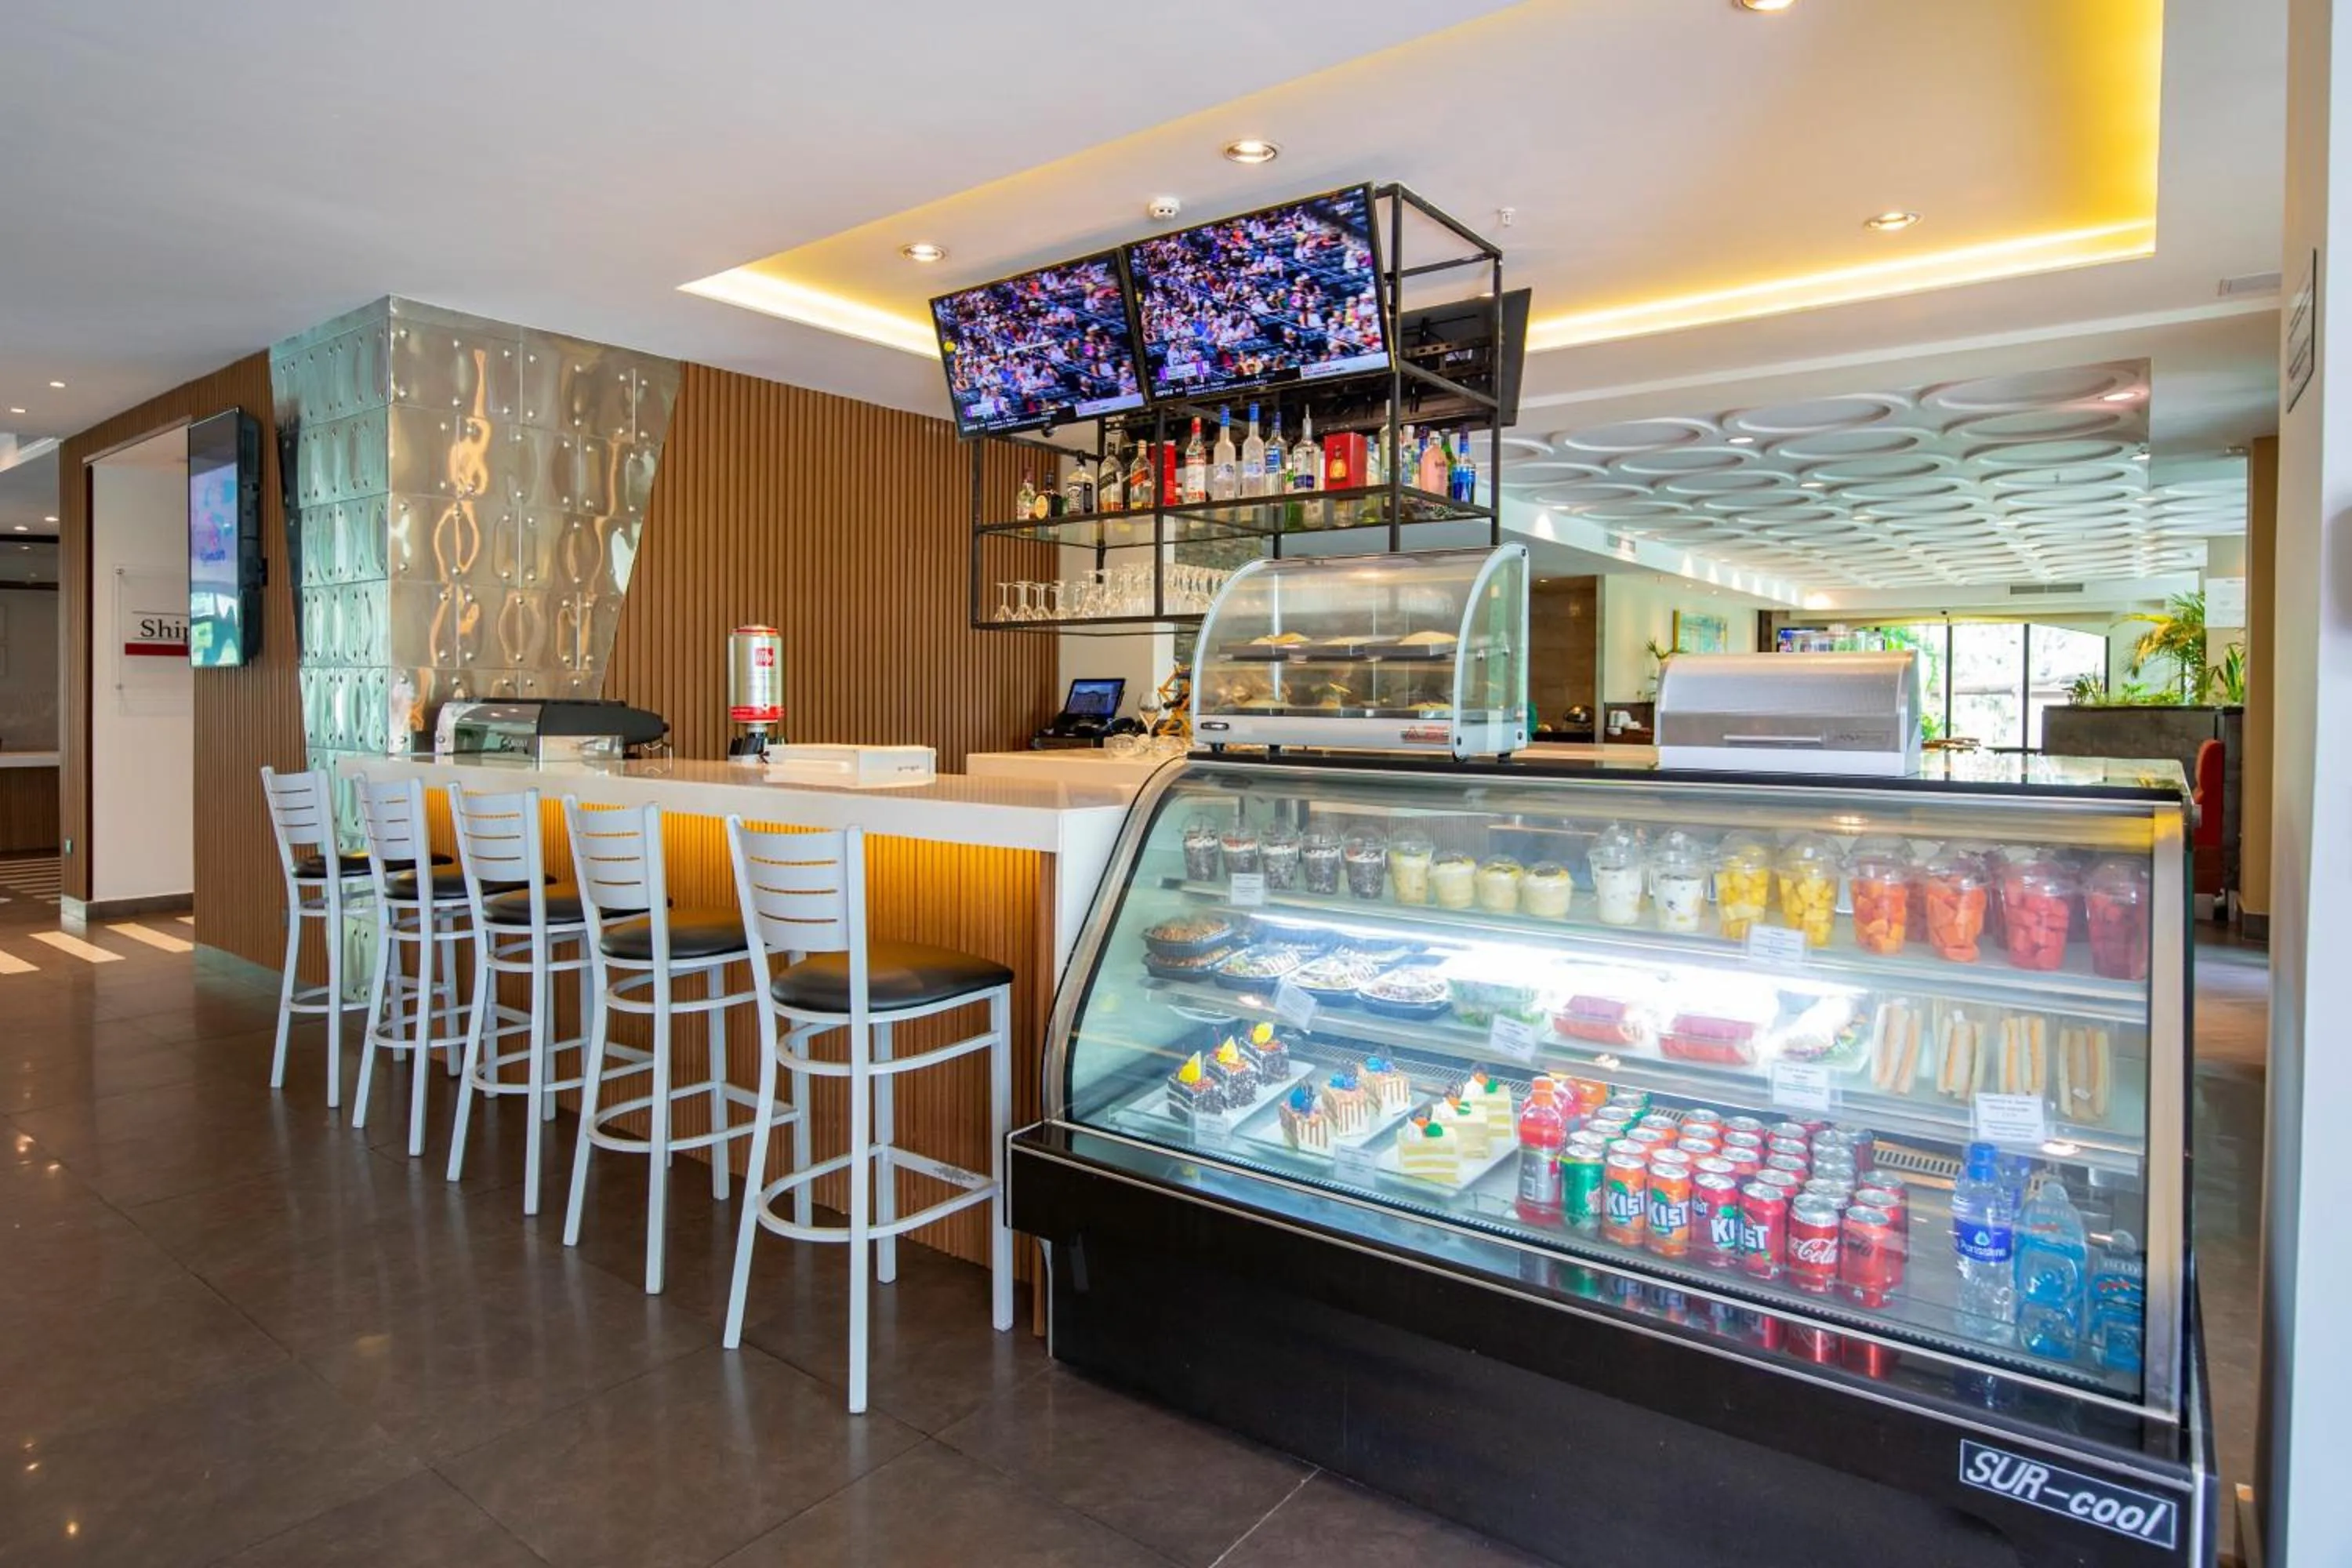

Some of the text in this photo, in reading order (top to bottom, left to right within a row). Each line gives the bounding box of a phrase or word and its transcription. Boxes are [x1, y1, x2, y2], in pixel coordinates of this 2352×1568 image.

[1607, 1191, 1646, 1218] KIST
[1648, 1200, 1690, 1227] KIST
[1966, 1451, 2167, 1537] SUR-cool
